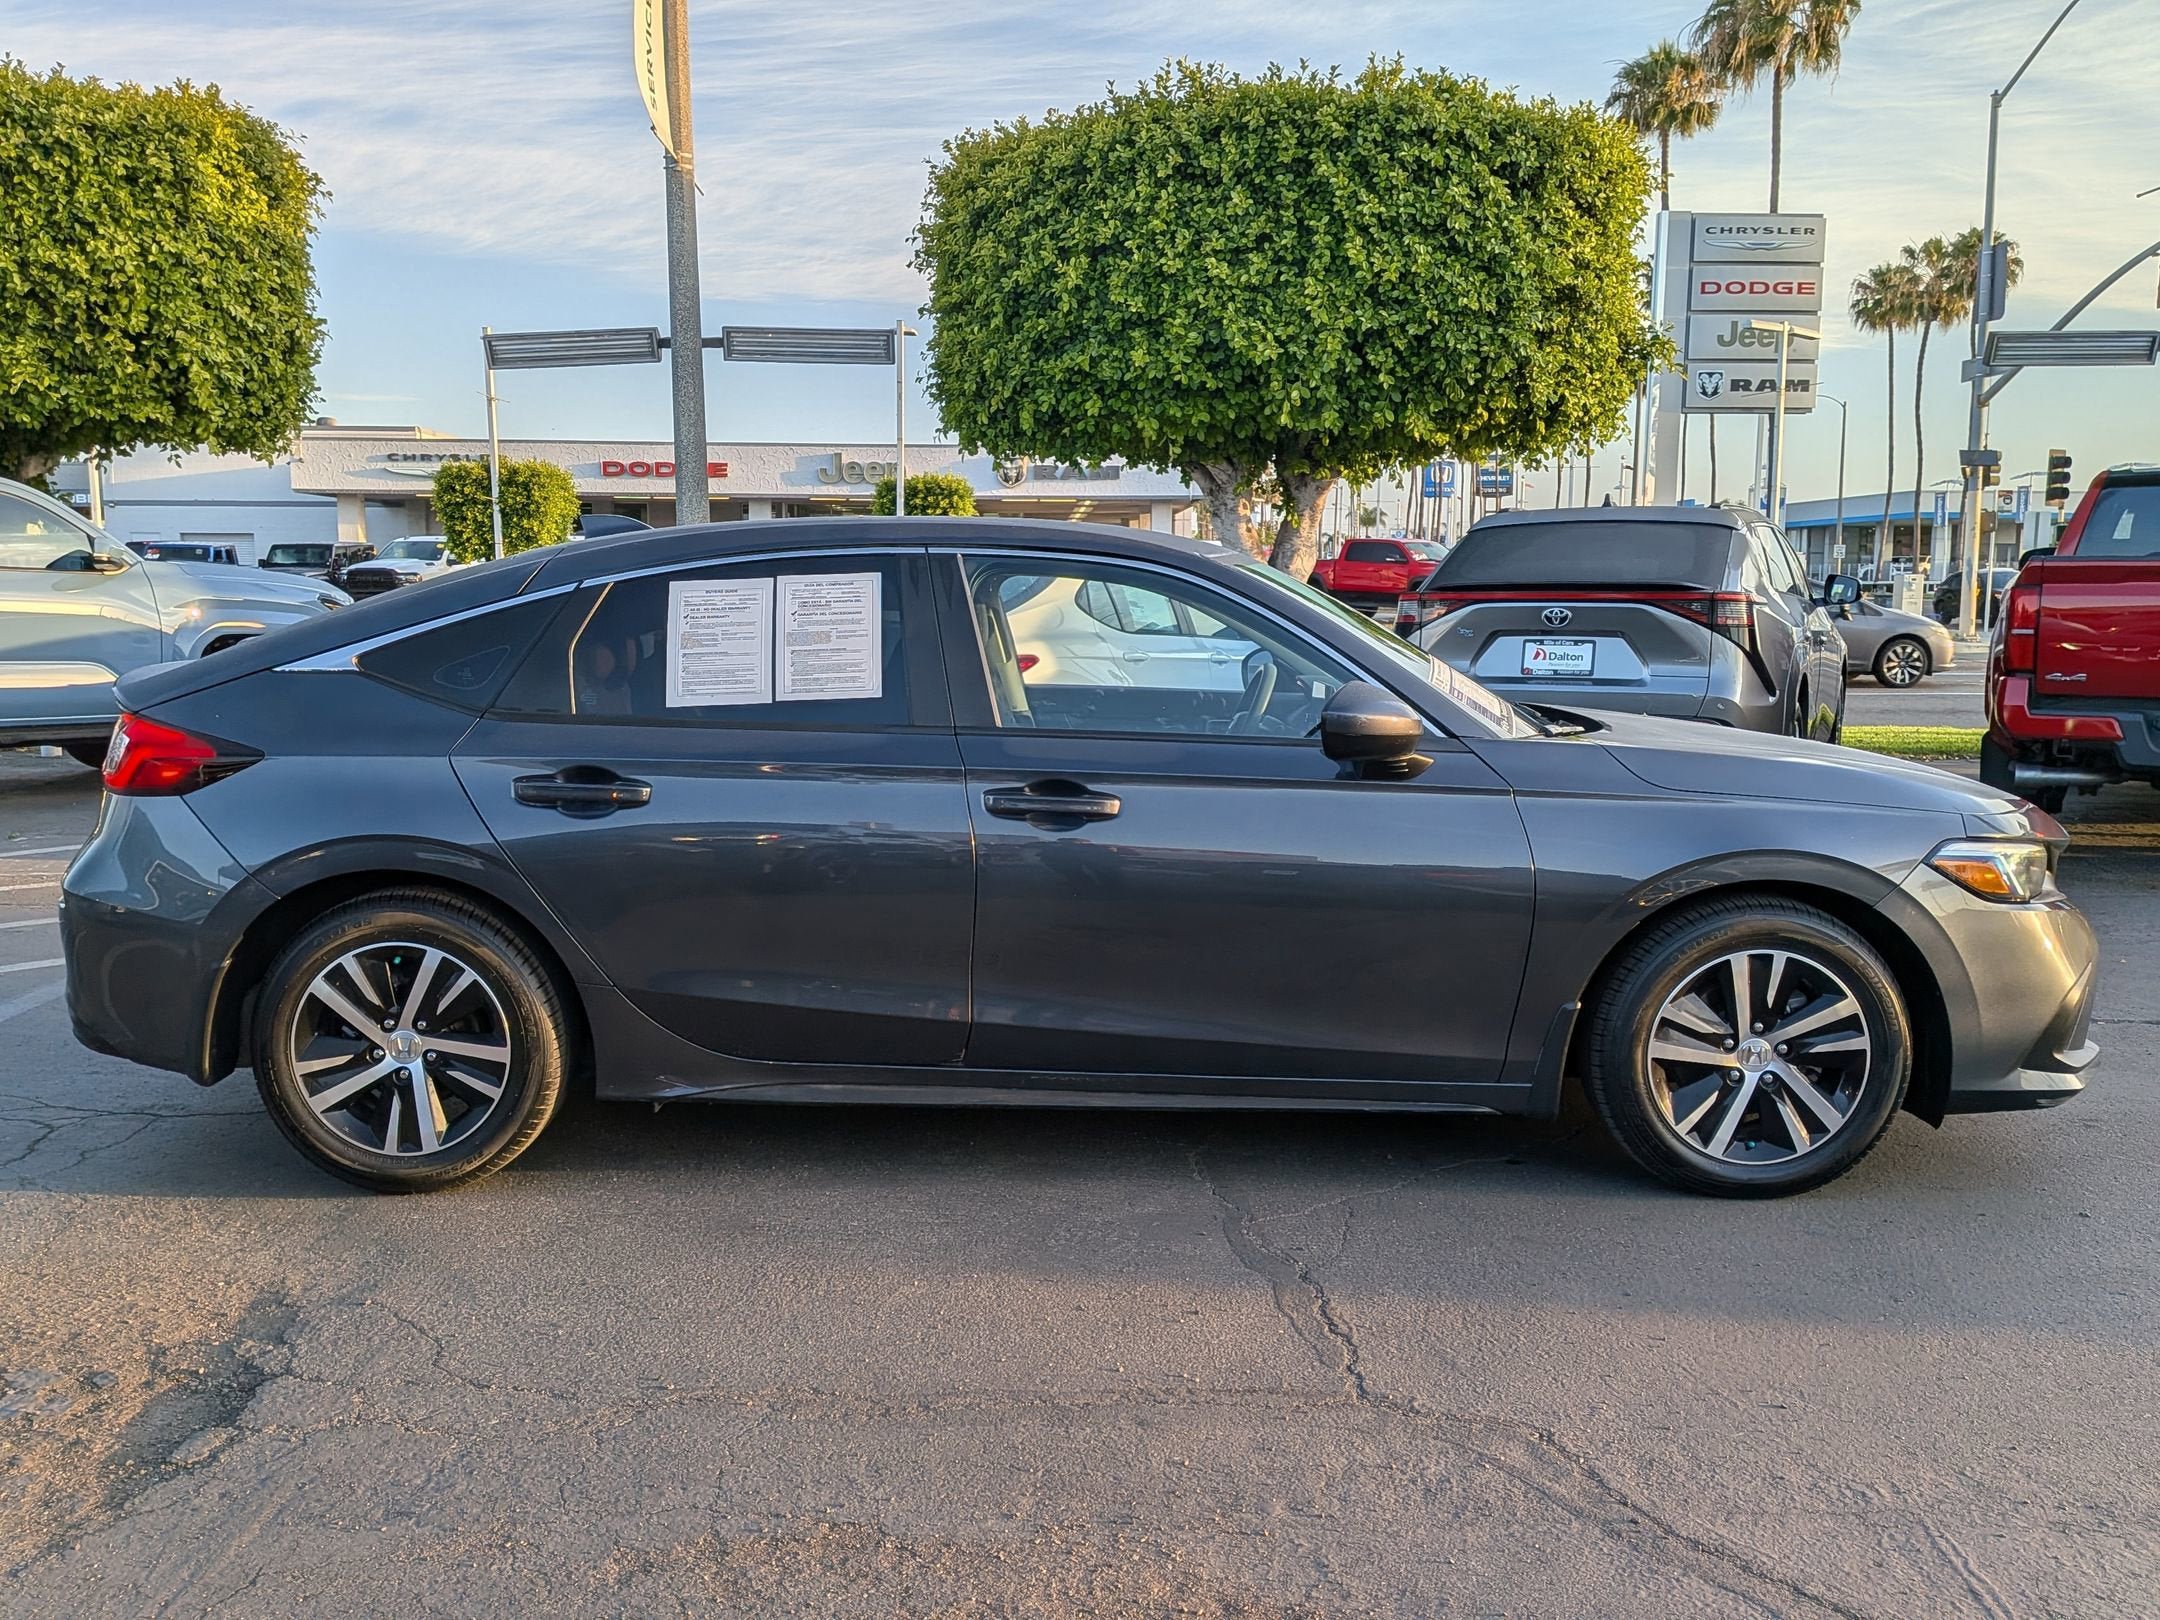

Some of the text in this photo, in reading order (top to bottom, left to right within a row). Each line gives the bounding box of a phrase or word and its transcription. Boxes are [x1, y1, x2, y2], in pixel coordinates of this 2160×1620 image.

[1705, 226, 1816, 236] CHRYSLER
[1700, 281, 1816, 295] DODGE
[1730, 378, 1810, 393] RAM
[386, 452, 491, 463] CHRYSLE
[600, 460, 729, 478] DODE
[1034, 464, 1121, 480] RAM
[1548, 652, 1584, 661] Dalton
